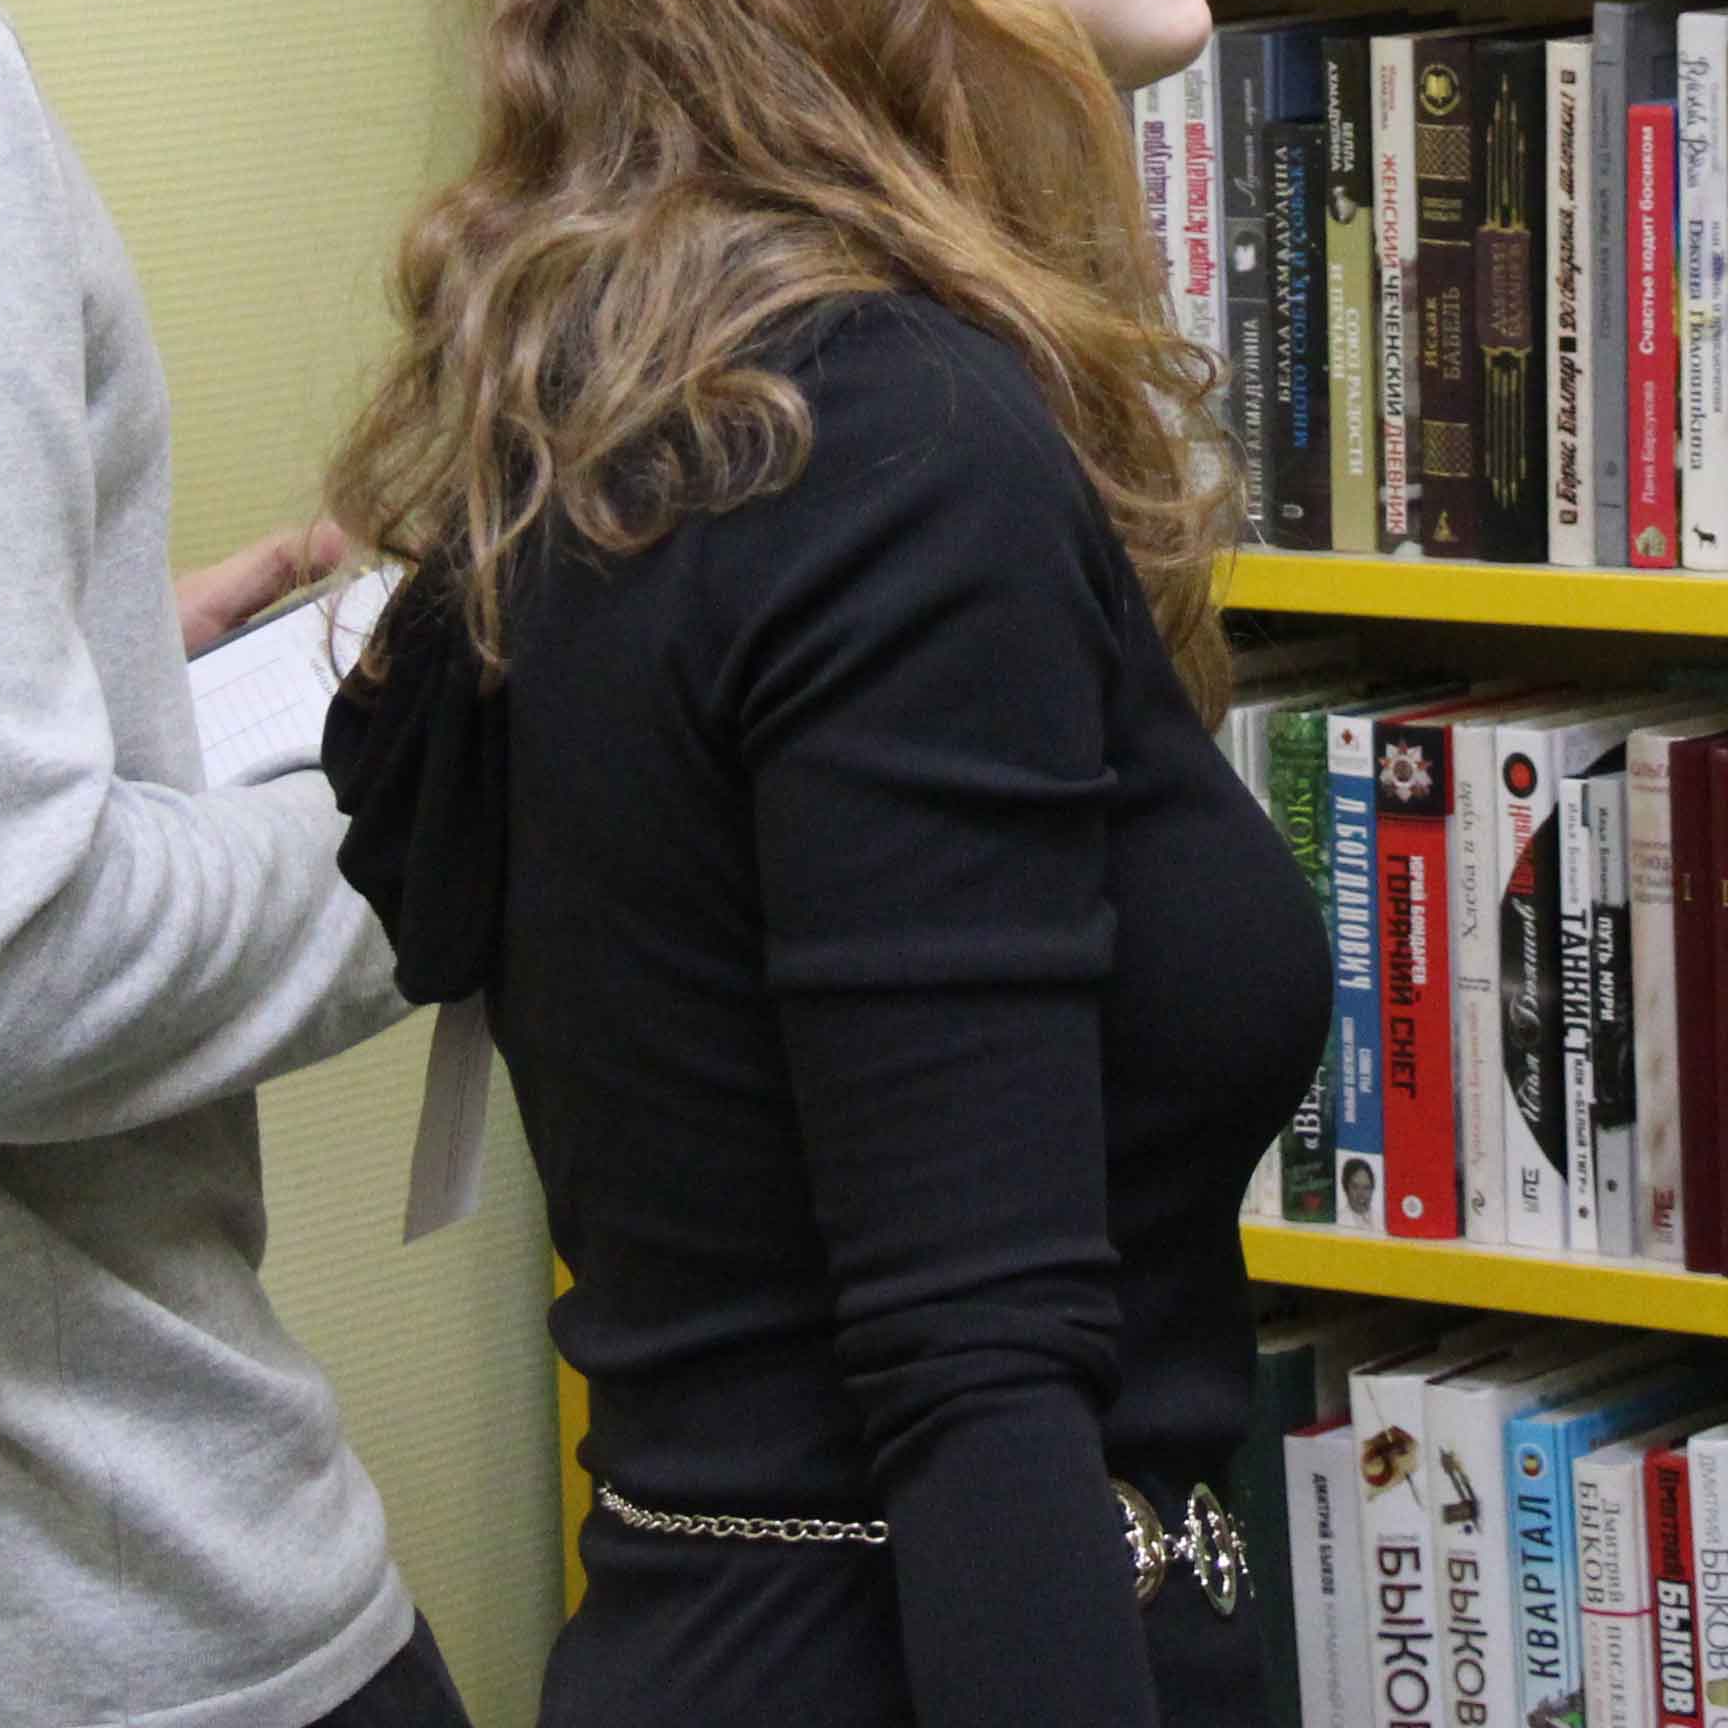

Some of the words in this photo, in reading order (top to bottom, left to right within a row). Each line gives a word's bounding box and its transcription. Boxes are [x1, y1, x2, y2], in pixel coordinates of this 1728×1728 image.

[1327, 61, 1343, 171] АХМАДУЛИНА
[1342, 123, 1355, 171] БЕЛЛА
[1184, 123, 1210, 235] Аствацатуров
[1289, 144, 1307, 241] СОБАКА
[1638, 125, 1656, 210] босиком
[1275, 144, 1292, 317] АХМАДУЛИНА
[1380, 153, 1403, 270] ЖЕНСКИЙ
[1639, 216, 1658, 272] ходит
[1185, 239, 1210, 297] Андрей
[1687, 219, 1705, 300] Джона
[1291, 275, 1308, 355] СОБАК
[1328, 287, 1345, 379] ПЕЧАЛИ
[1343, 307, 1361, 370] СОЮЗ
[1382, 274, 1403, 416] ЧЕЧЕНСКИЙ
[1424, 297, 1438, 367] Исаак
[1443, 286, 1461, 379] БАБЕЛЬ
[1638, 278, 1656, 355] Счастье
[1243, 318, 1263, 450] АХМАДУЛИНА
[1277, 321, 1291, 403] БЕЛЛА
[1557, 354, 1582, 436] Балтер
[1292, 364, 1310, 449] МНОГО
[1345, 374, 1365, 476] РАДОСТИ
[1639, 381, 1658, 462] Барсукова
[1384, 423, 1406, 533] ДНЕВНИК
[1557, 442, 1579, 505] Борис
[1640, 467, 1655, 505] Лана
[1457, 781, 1476, 832] чуда
[1464, 840, 1476, 854] и
[1409, 855, 1425, 899] ЮРИЙ
[1460, 863, 1480, 940] Хлеба
[1386, 854, 1420, 1007] ГОРЯЧИЙ
[1410, 902, 1426, 984] БОНДАРЕВ
[1510, 898, 1540, 1029] Бояшов
[1596, 916, 1614, 964] ПУТЬ
[1561, 908, 1592, 1063] ТАНКИСТ
[1599, 971, 1616, 1022] МУРИ
[1390, 1016, 1416, 1098] СНЕГ
[1520, 1051, 1540, 1122] Илья
[1573, 1058, 1587, 1085] ИЛИ
[1311, 1473, 1332, 1537] ДМИТРИЙ
[1578, 1481, 1604, 1604] БЫКОВ
[1319, 1544, 1335, 1595] БЫКОВ
[1518, 1495, 1559, 1679] КВАРТАЛ
[1601, 1498, 1624, 1603] Дмитрий
[1447, 1555, 1488, 1727] БЫКОВ
[1658, 1580, 1695, 1714] БЫКОВ
